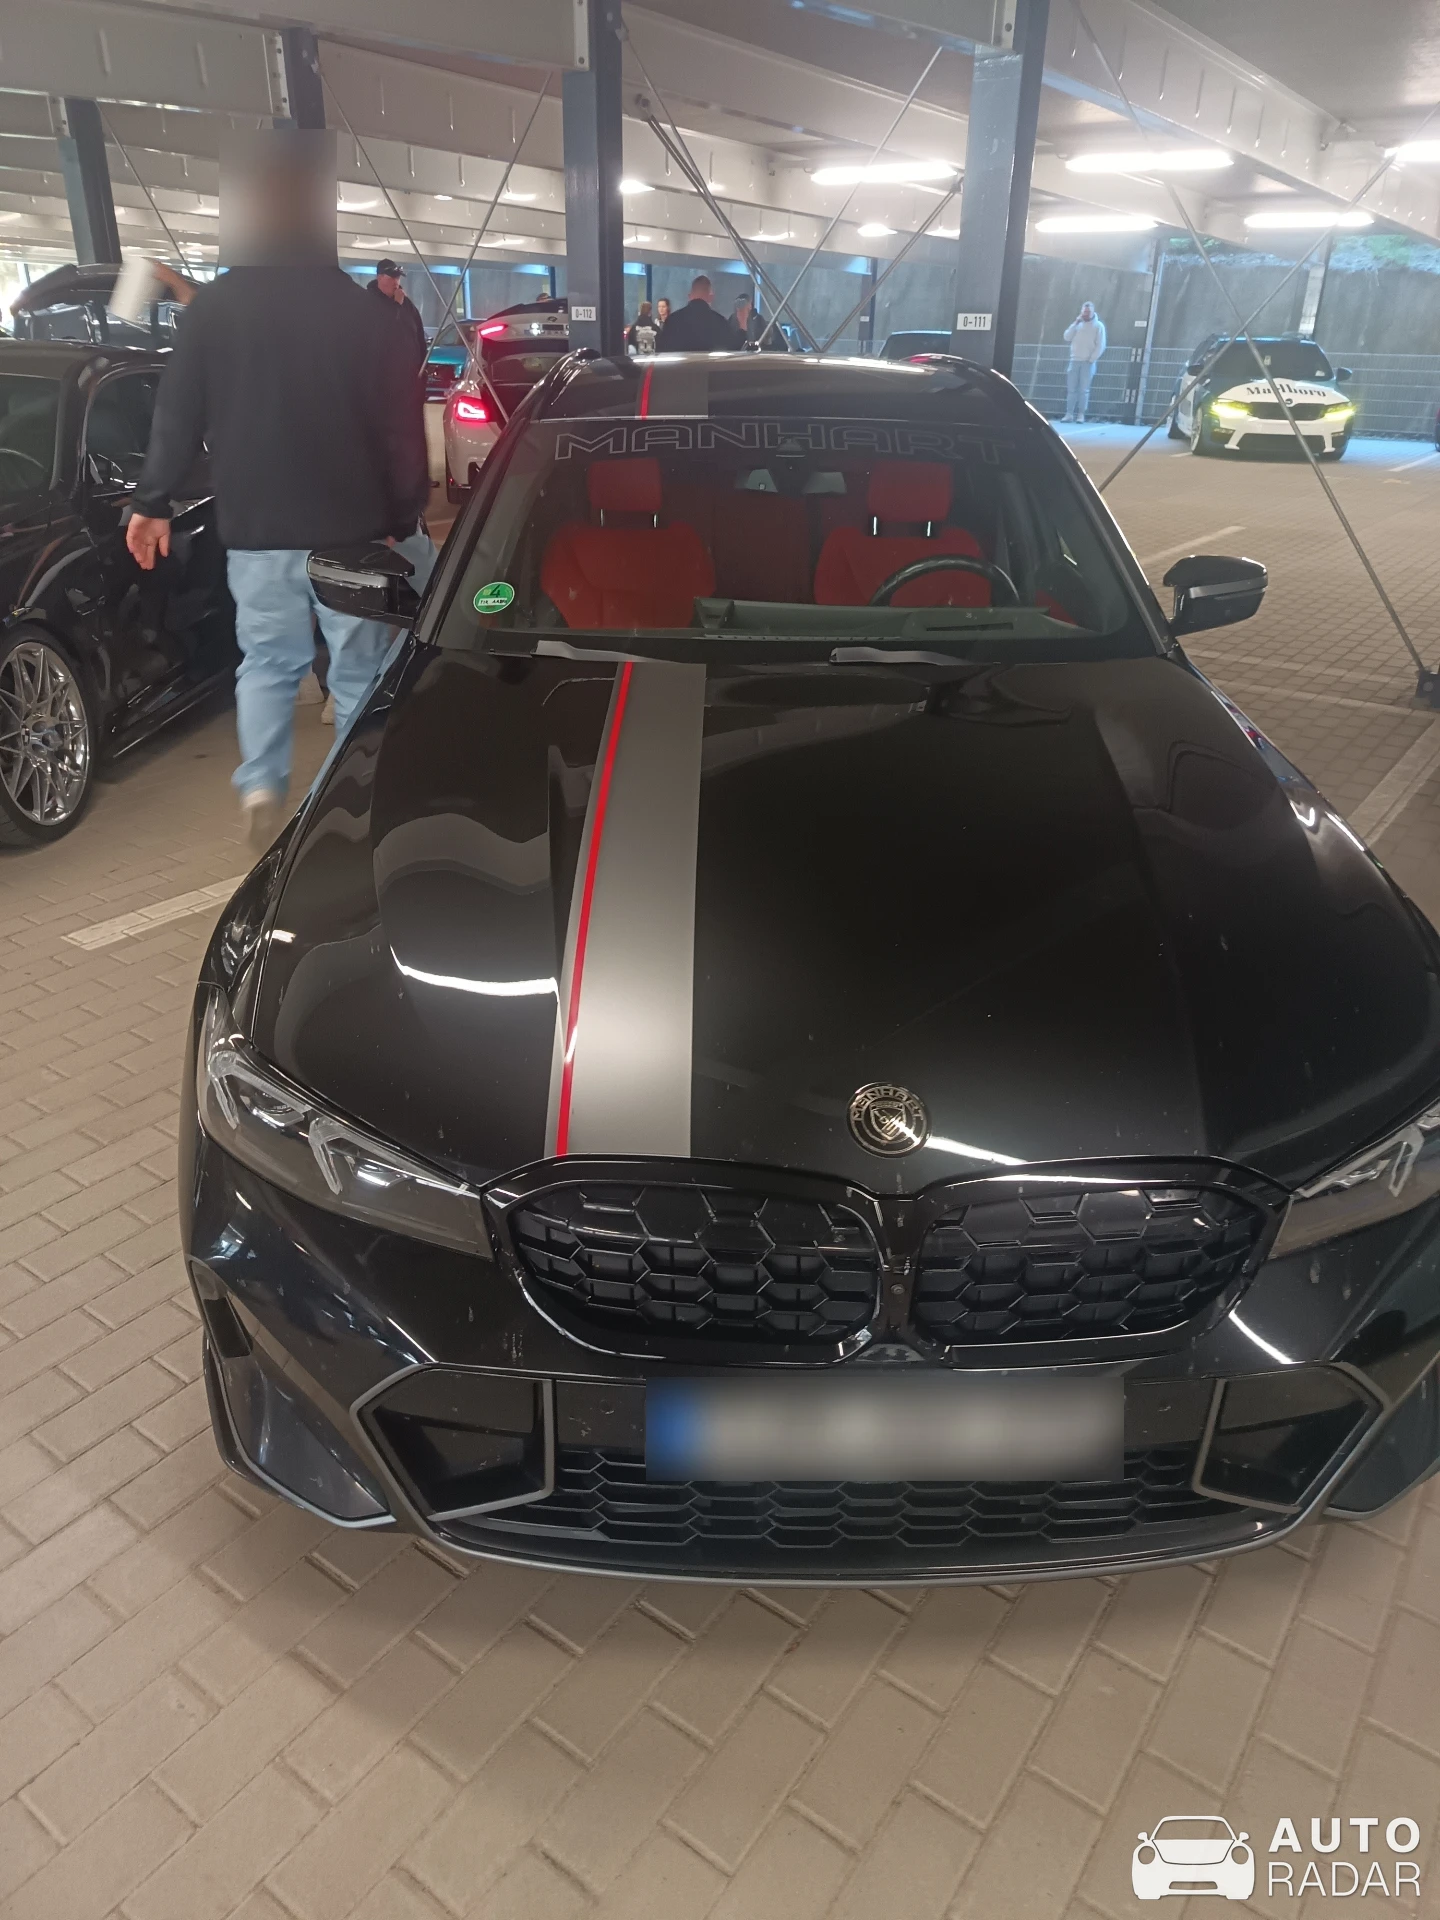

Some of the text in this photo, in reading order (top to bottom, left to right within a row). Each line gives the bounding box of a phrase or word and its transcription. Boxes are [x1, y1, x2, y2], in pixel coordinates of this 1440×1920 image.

[1246, 383, 1327, 398] Malboro
[555, 422, 1015, 464] MANHART
[490, 584, 501, 598] 4
